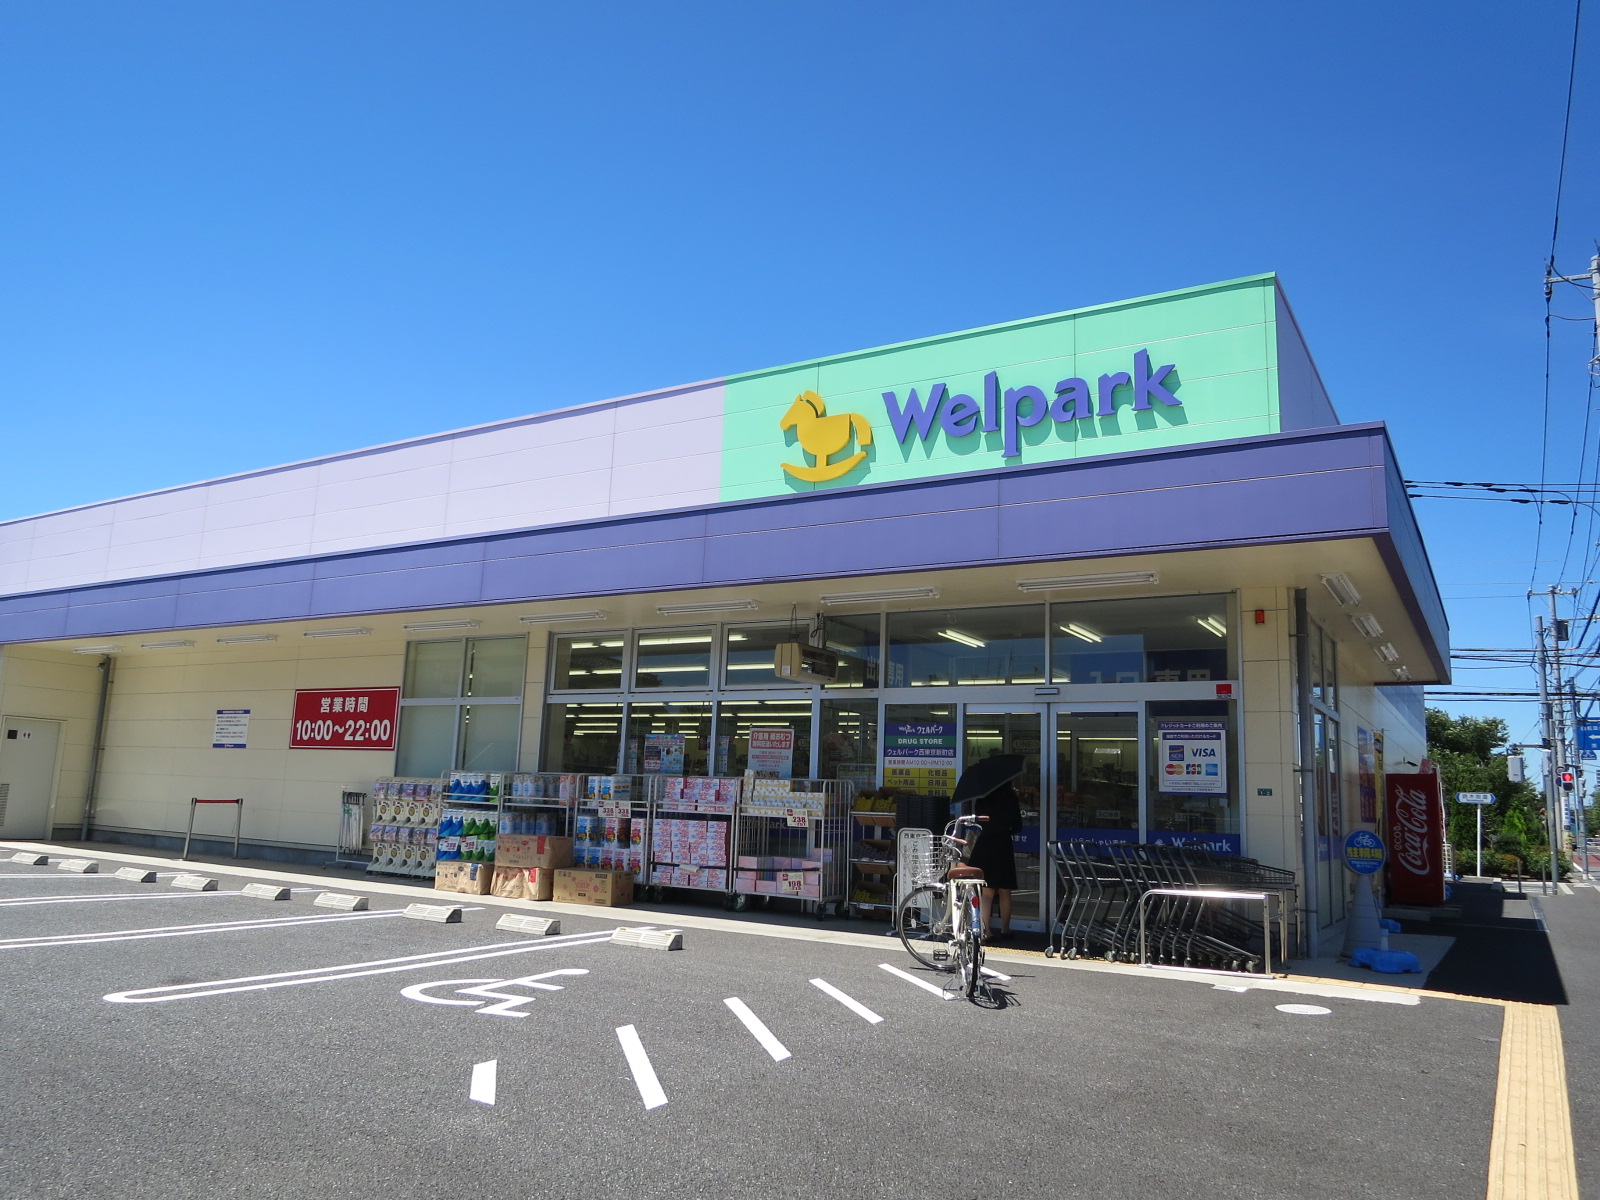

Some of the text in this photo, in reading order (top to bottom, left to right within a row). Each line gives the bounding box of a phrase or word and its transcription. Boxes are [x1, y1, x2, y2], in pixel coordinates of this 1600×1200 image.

[881, 348, 1183, 458] Welpark
[320, 696, 369, 713] 営業時間
[916, 724, 943, 735] ウェルパーク
[1191, 748, 1216, 757] VISA
[1395, 784, 1430, 876] Coca-Cola
[1347, 847, 1385, 860] 駐輪場
[787, 880, 802, 888] 198
